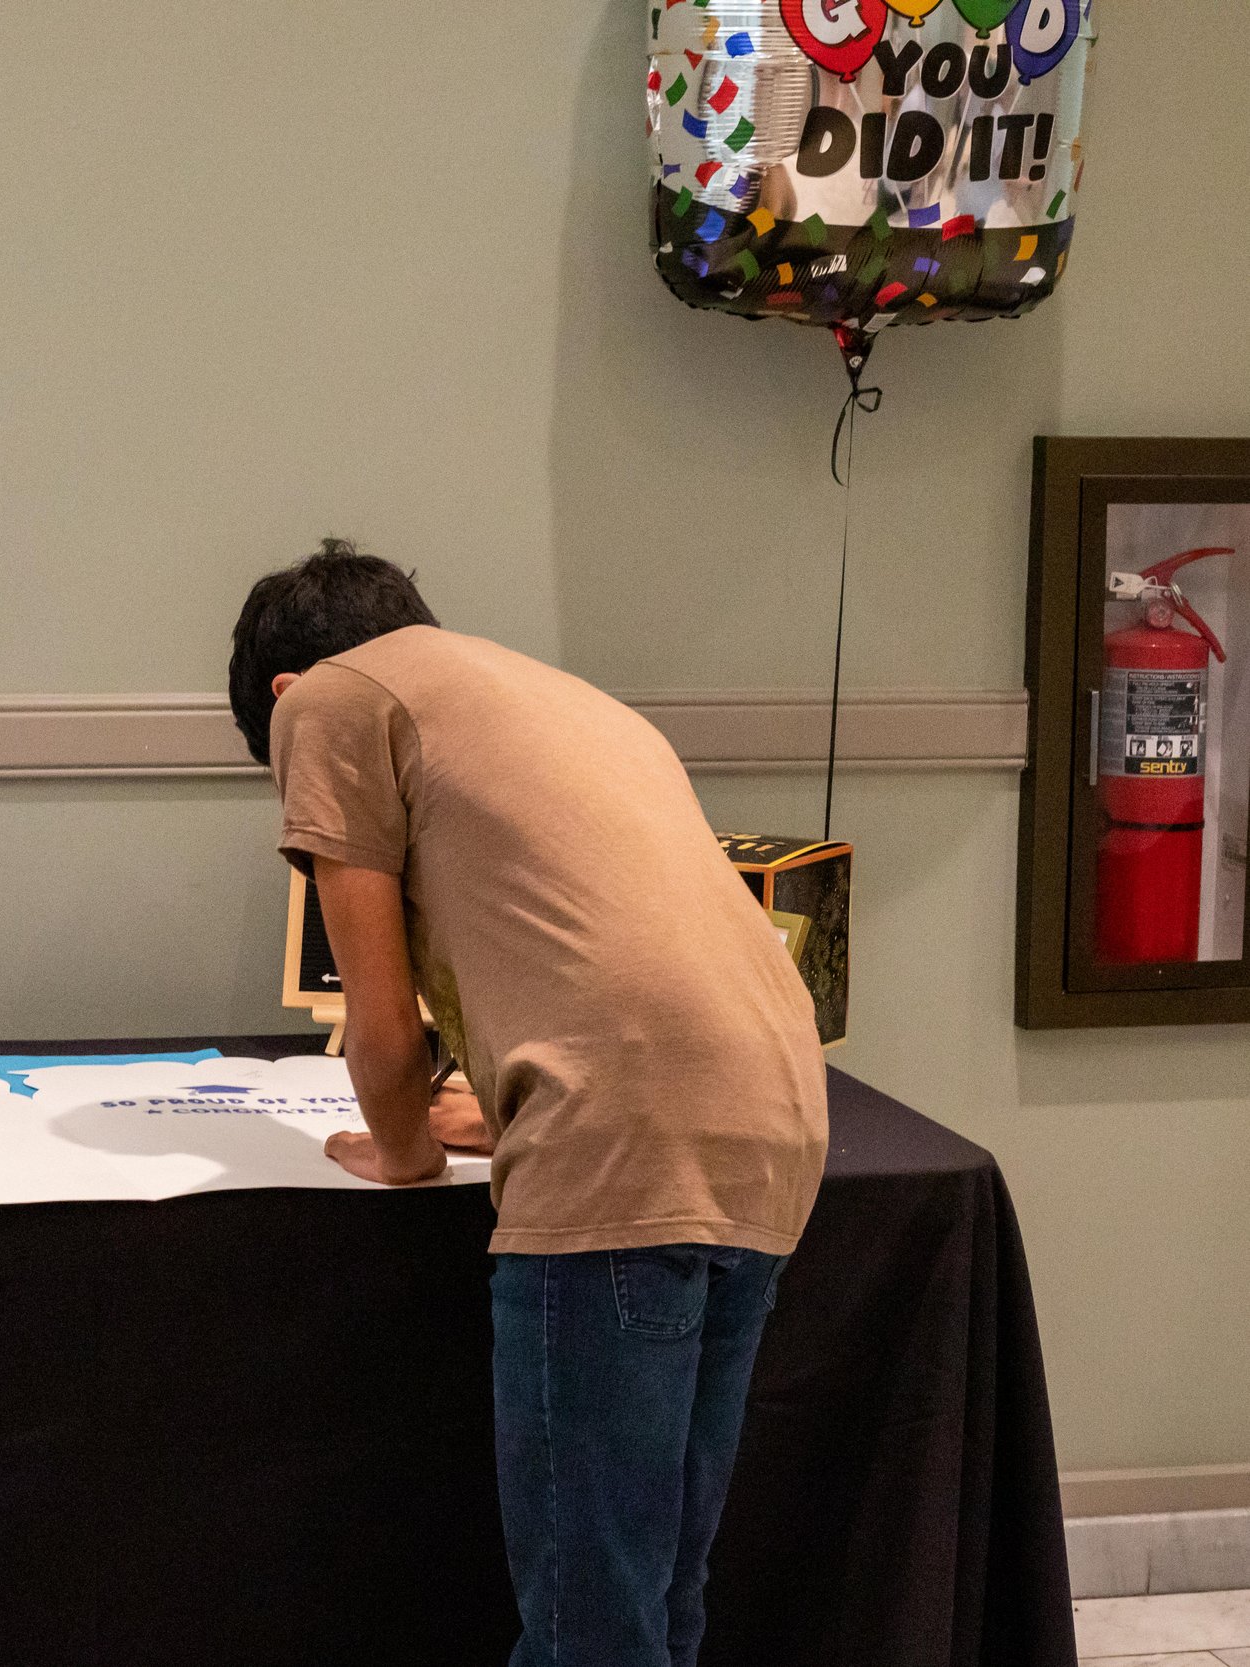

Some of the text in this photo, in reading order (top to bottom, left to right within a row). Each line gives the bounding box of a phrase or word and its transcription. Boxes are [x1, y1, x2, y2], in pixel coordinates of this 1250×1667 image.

[873, 39, 1013, 99] YOU
[795, 106, 1055, 182] DID IT!
[1139, 760, 1187, 773] sentry
[100, 1100, 137, 1108] SO
[148, 1098, 246, 1106] PROUD
[299, 1096, 358, 1104] YOU
